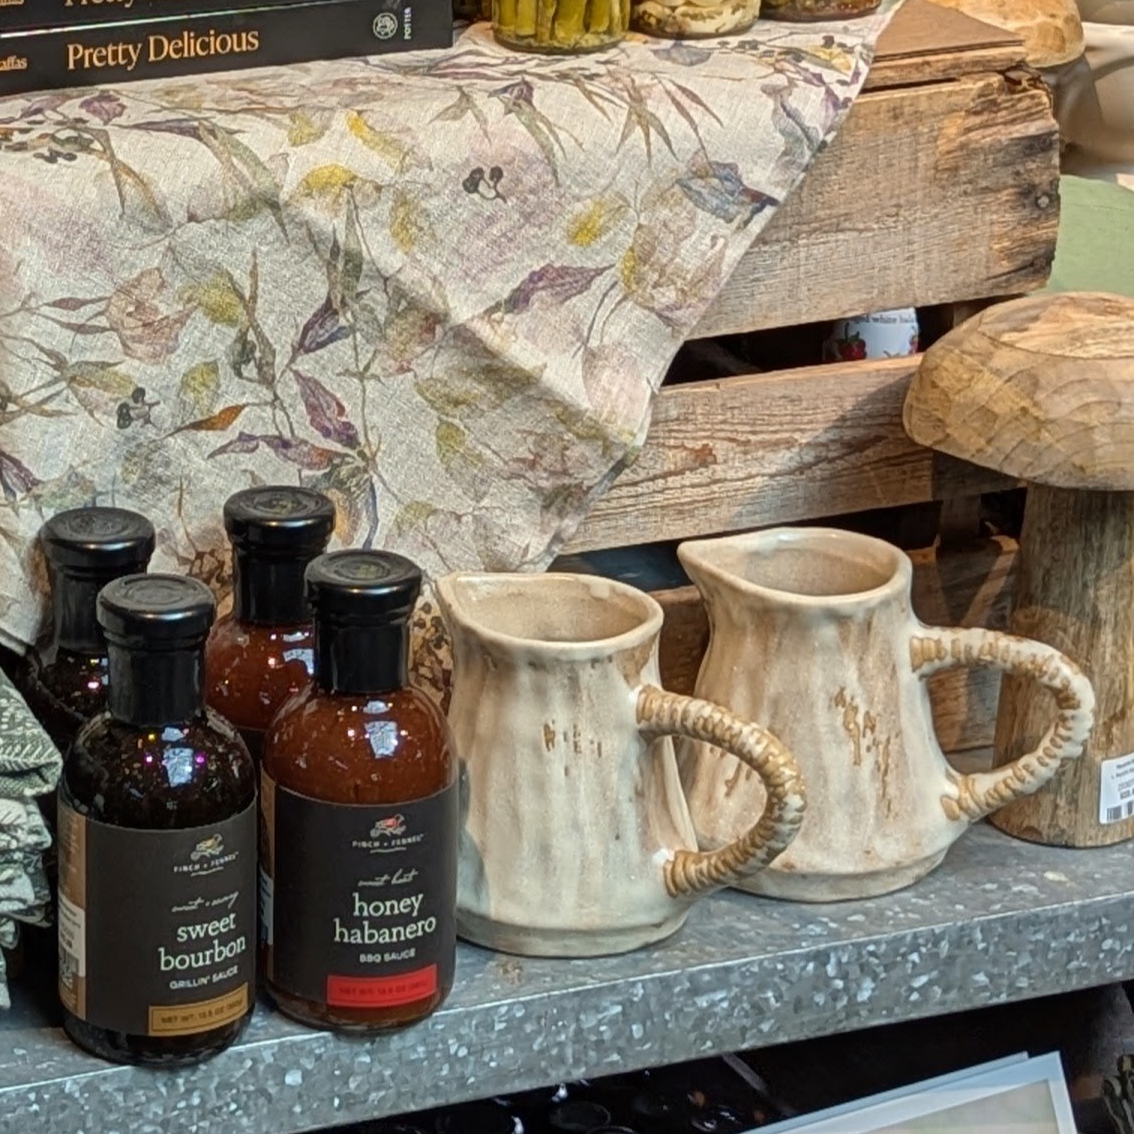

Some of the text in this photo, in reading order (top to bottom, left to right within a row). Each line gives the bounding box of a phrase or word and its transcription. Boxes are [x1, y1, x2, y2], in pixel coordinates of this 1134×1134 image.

[67, 29, 260, 71] Pretty Delicious
[352, 892, 424, 917] honey
[176, 913, 237, 943] sweet
[333, 916, 436, 944] habanero
[158, 935, 246, 971] bourbon
[360, 947, 415, 963] BBQ SAUCE
[212, 965, 238, 983] SAUCE
